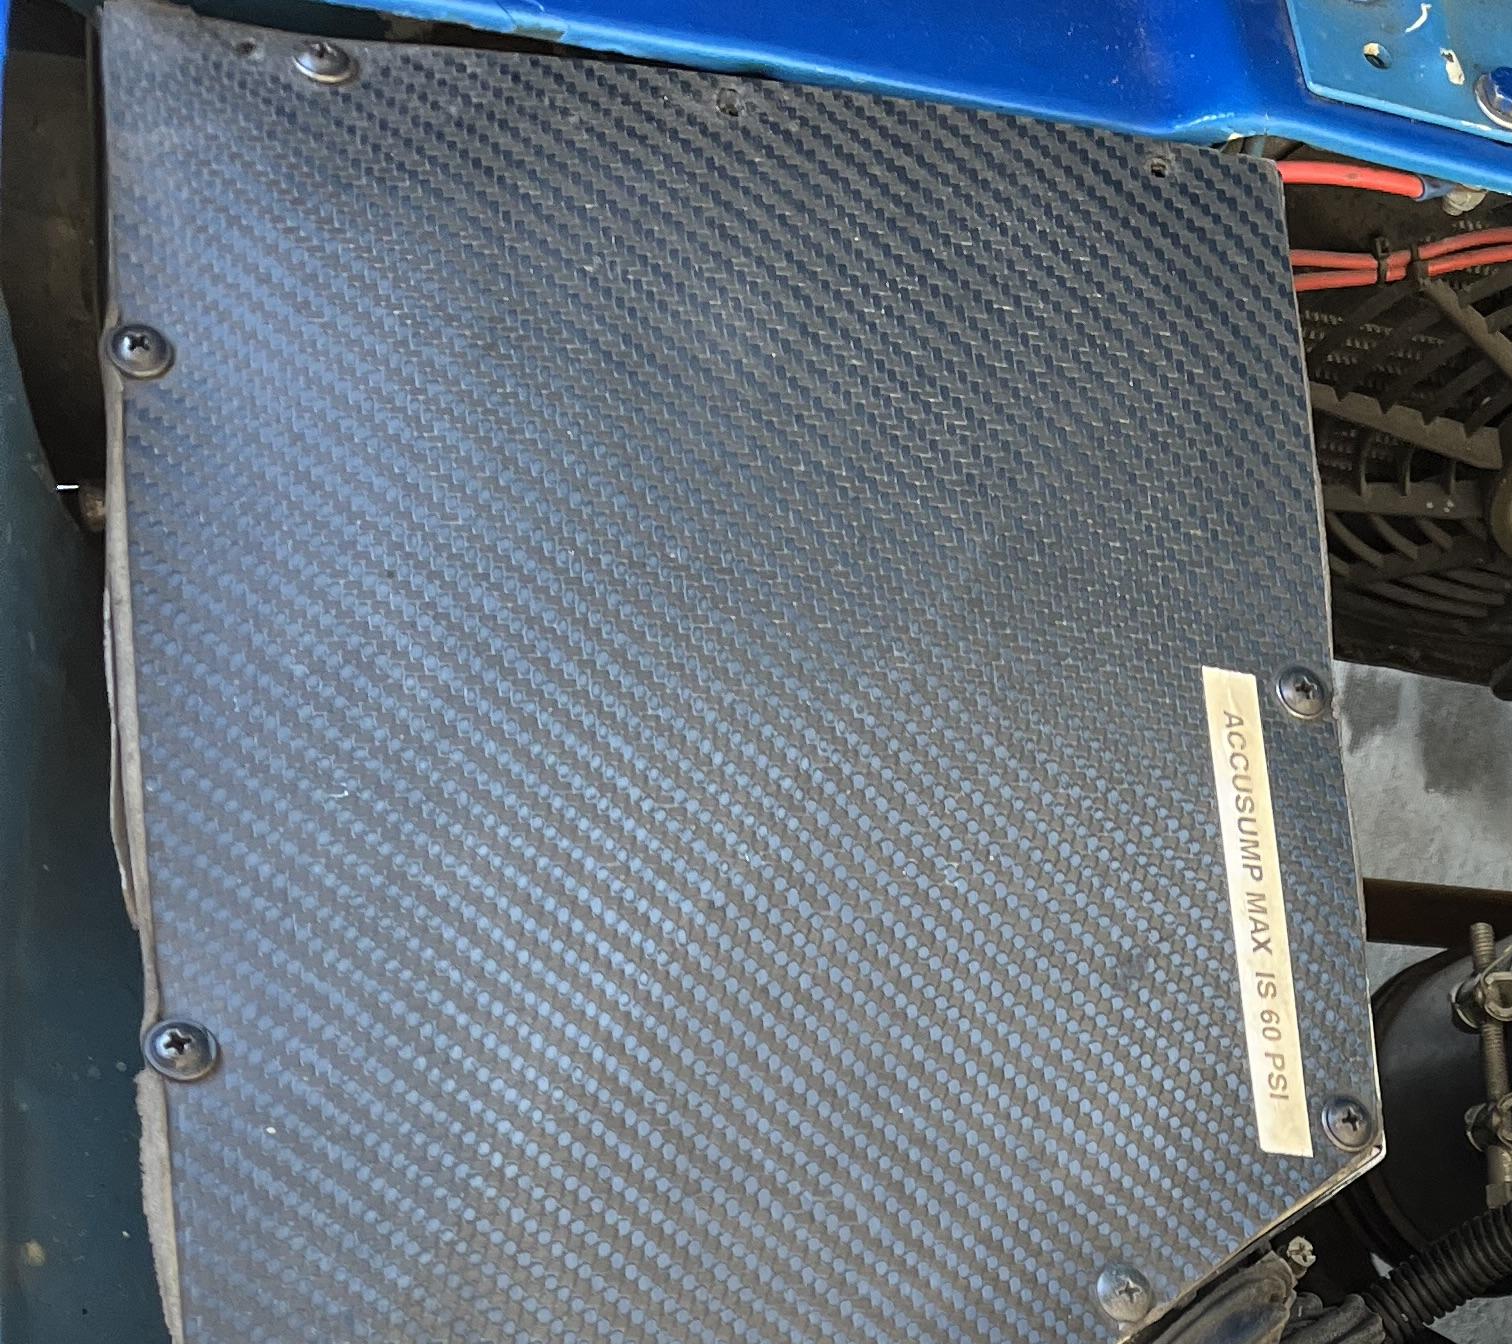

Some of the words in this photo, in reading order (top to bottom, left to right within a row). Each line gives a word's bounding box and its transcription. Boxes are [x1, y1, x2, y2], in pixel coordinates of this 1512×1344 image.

[1222, 708, 1264, 883] ACCUSUMP
[1244, 890, 1273, 955] MAX
[1254, 970, 1278, 1001] IS
[1260, 1009, 1283, 1042] 60
[1264, 1052, 1291, 1101] PSI
